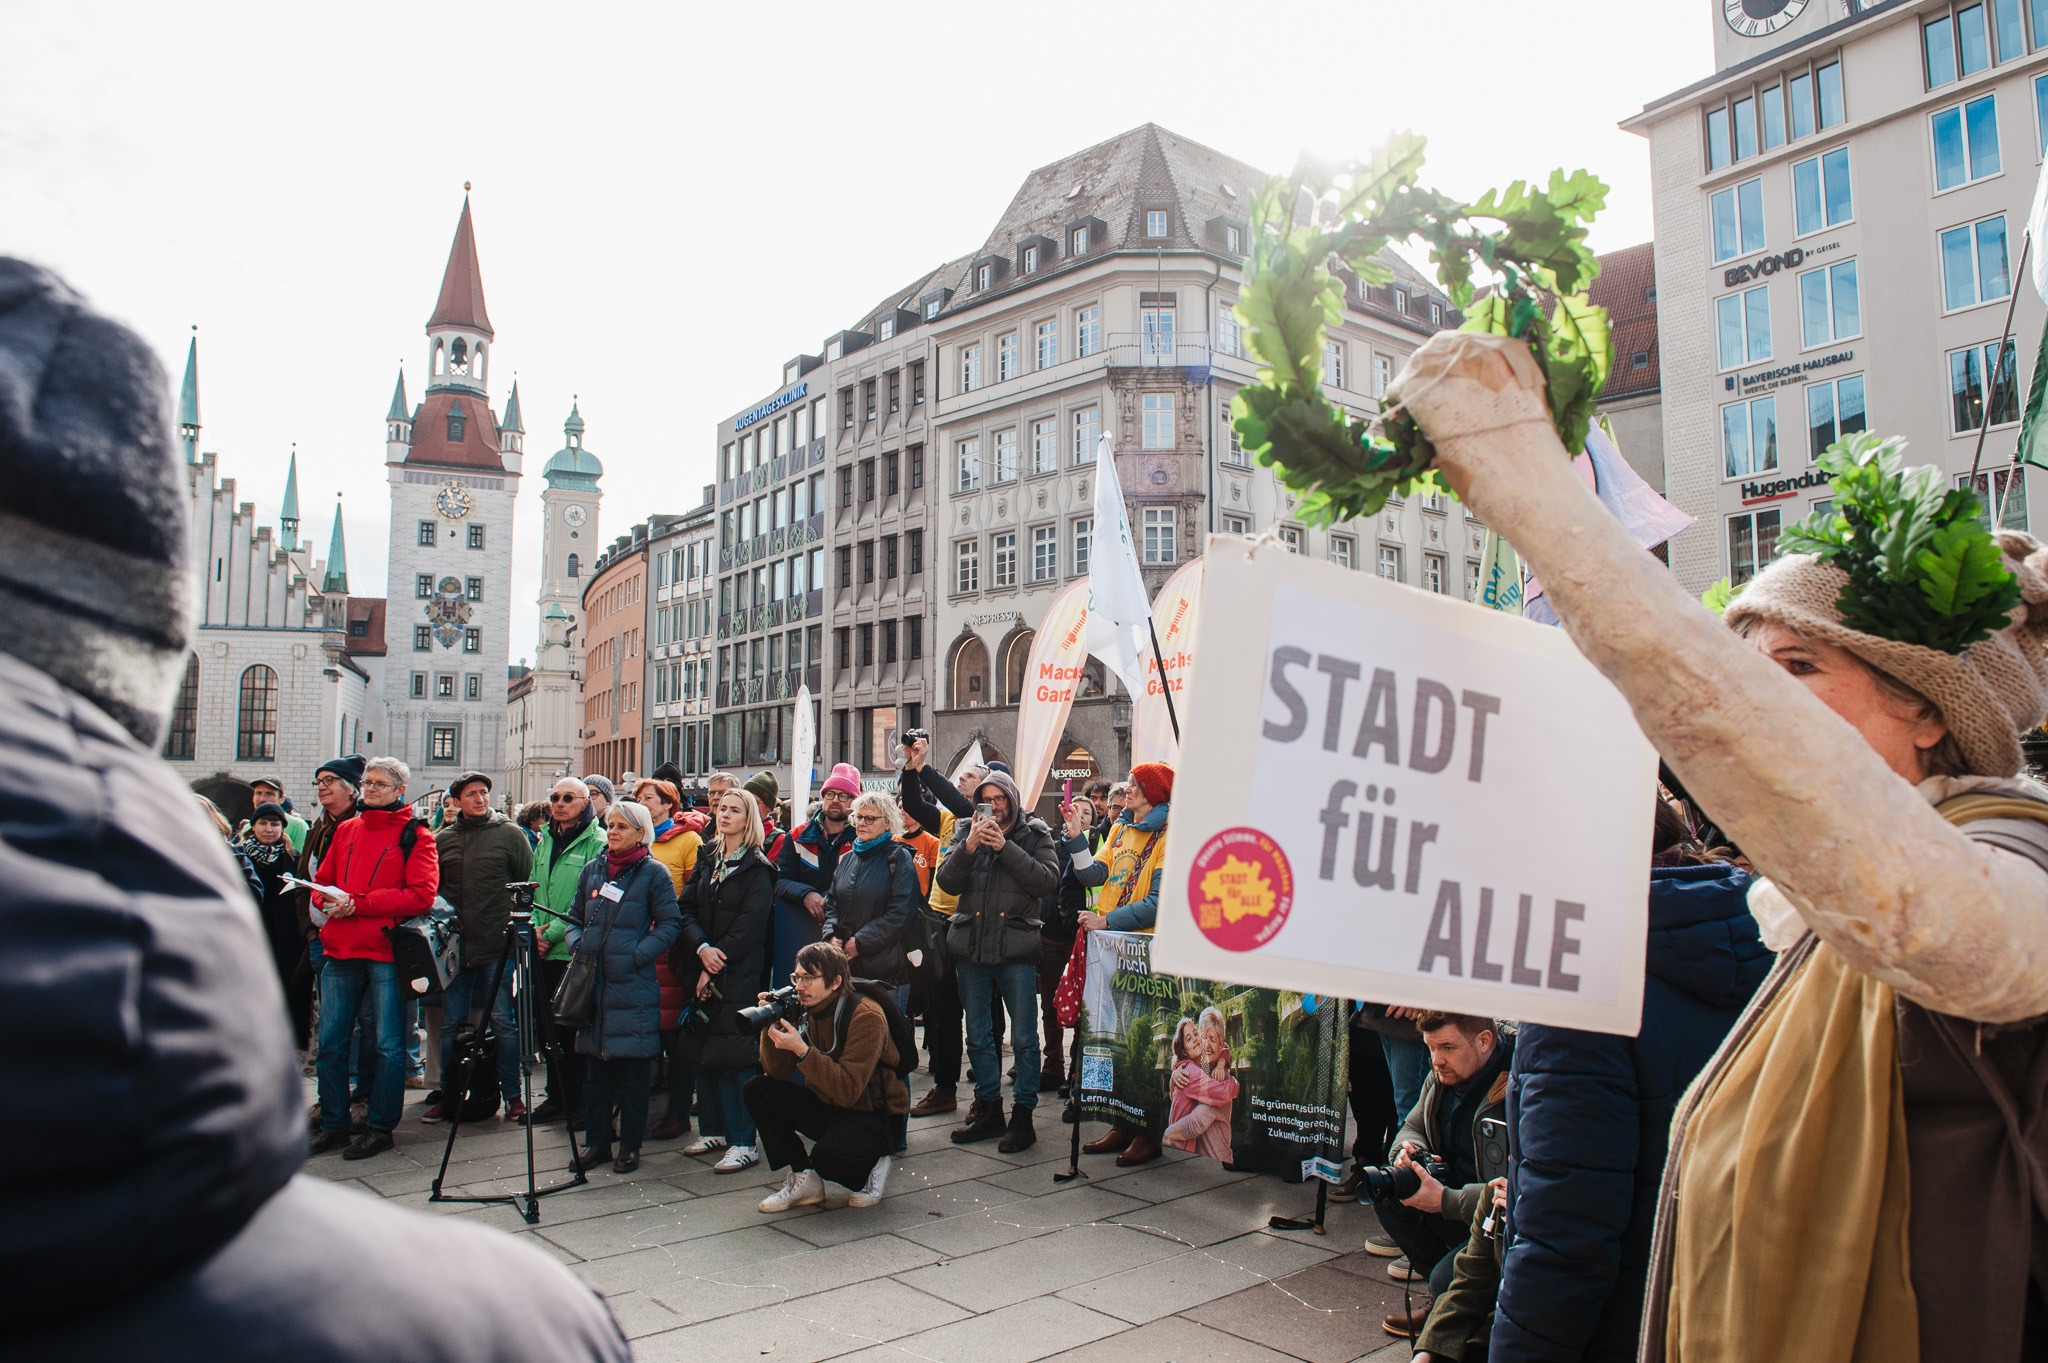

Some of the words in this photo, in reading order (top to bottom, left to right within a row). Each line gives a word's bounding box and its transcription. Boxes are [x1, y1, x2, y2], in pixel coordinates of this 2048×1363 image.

[1805, 249, 1814, 257] BY
[1816, 242, 1841, 254] GEISEL
[1742, 363, 1801, 387] BAYERISCHE
[1802, 350, 1854, 371] HAUSBAU
[1768, 381, 1779, 390] DIE
[733, 382, 808, 432] AUGENTAGESKLINIK
[1741, 469, 1839, 499] Hugendub
[971, 610, 1018, 627] NESPRESSO
[1262, 645, 1501, 784] STADT
[1051, 768, 1092, 780] NESPRESSO
[862, 780, 895, 791] AROVSKI
[1318, 778, 1440, 895] für
[1219, 873, 1248, 885] STADT
[1240, 895, 1262, 907] ALLE
[1417, 879, 1586, 993] ALLE
[1127, 940, 1147, 957] mit
[1117, 956, 1148, 975] nach
[1110, 970, 1173, 999] MORGEN
[1080, 1093, 1108, 1103] Lerne
[1251, 1094, 1266, 1107] Eine
[1252, 1112, 1267, 1122] und
